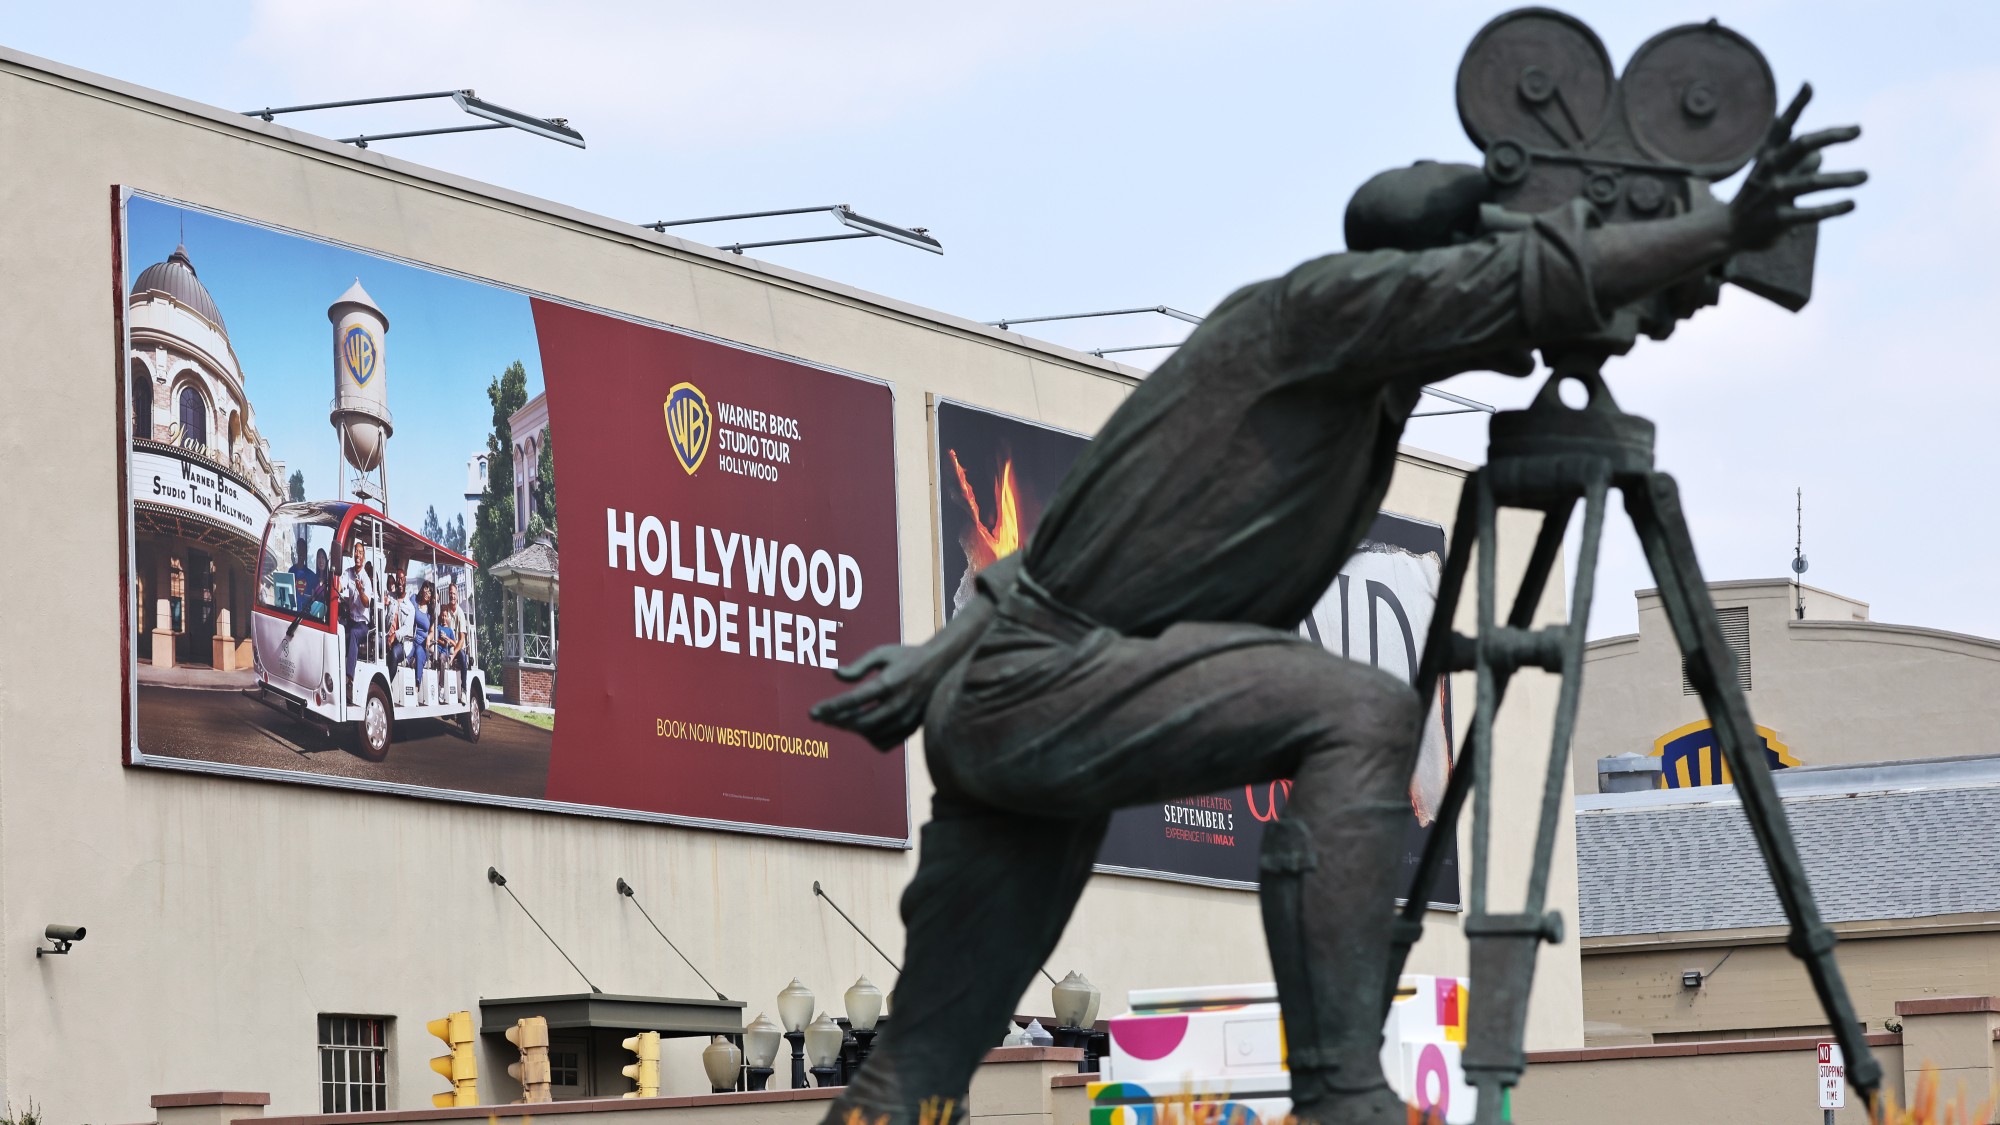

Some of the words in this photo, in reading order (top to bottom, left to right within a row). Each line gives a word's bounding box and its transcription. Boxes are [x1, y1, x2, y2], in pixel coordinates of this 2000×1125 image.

[346, 333, 373, 379] WB
[671, 397, 705, 460] WB
[717, 401, 767, 434] WARNER
[769, 414, 802, 441] BROS.
[719, 428, 758, 457] STUDIO
[761, 437, 791, 464] TOUR
[719, 454, 778, 482] HOLLYWOOD
[153, 475, 186, 500] STUDIO
[189, 484, 212, 509] TOUR
[214, 493, 253, 526] HOLLYWOOD
[606, 507, 863, 611] HOLLYWOOD
[634, 585, 741, 655] MADE
[748, 606, 839, 670] HERE
[656, 718, 688, 740] BOOK
[689, 722, 715, 743] NOW
[716, 726, 829, 759] WBSTUDIOTOUR.COM
[1164, 804, 1226, 831] SEPTEMBER
[1227, 813, 1234, 831] 5
[1197, 795, 1233, 811] THEATERS
[1165, 827, 1200, 843] EXPERIENCE
[1200, 831, 1206, 843] IT
[1206, 833, 1213, 844] IN
[1212, 833, 1235, 847] IMAX
[1819, 1046, 1829, 1061] NO
[1820, 1065, 1844, 1078] STOPPING
[1826, 1079, 1837, 1089] ANY
[1826, 1091, 1838, 1101] TIME
